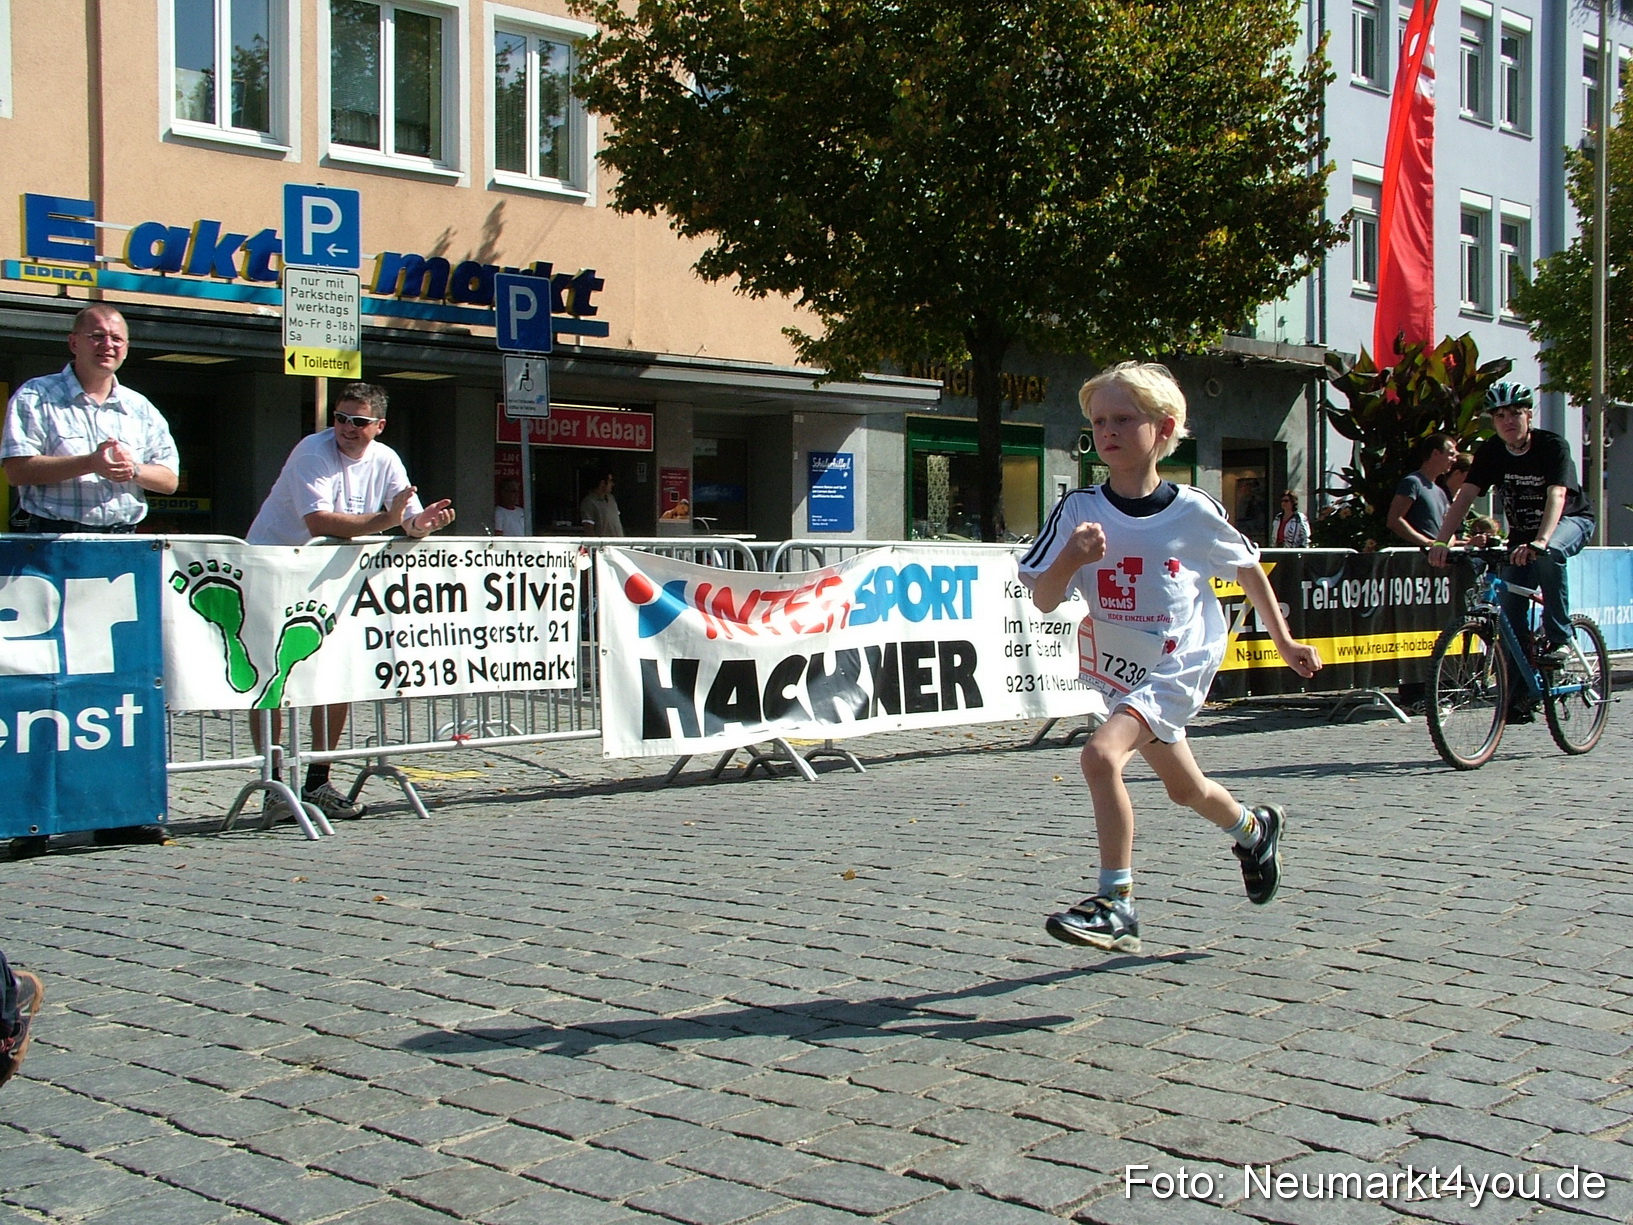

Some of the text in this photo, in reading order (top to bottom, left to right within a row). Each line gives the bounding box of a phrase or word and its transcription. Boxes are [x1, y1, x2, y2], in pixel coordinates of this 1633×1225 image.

[302, 195, 343, 256] P
[123, 219, 283, 283] akt
[24, 264, 95, 283] EDEKA
[300, 277, 345, 289] nur mit
[290, 286, 354, 303] Parkschein
[296, 302, 349, 318] werktags
[509, 285, 538, 341] P
[289, 330, 302, 342] Sa
[302, 355, 350, 370] Toiletten
[586, 415, 647, 446] Kebap
[359, 549, 576, 571] Orthopädie-Schuhtechnik
[351, 571, 575, 617] Adam Silvia
[1101, 596, 1134, 610] DKMS
[1301, 580, 1338, 610] Tel.:
[1415, 576, 1432, 605] 52
[1434, 575, 1450, 605] 26
[1004, 616, 1023, 634] Im
[1125, 614, 1155, 623] EINZELNE
[364, 620, 570, 651] Dreichlingerstr. 21
[1004, 640, 1032, 658] der
[375, 657, 458, 690] 92318
[1102, 651, 1147, 686] 7239
[0, 693, 143, 755] nst
